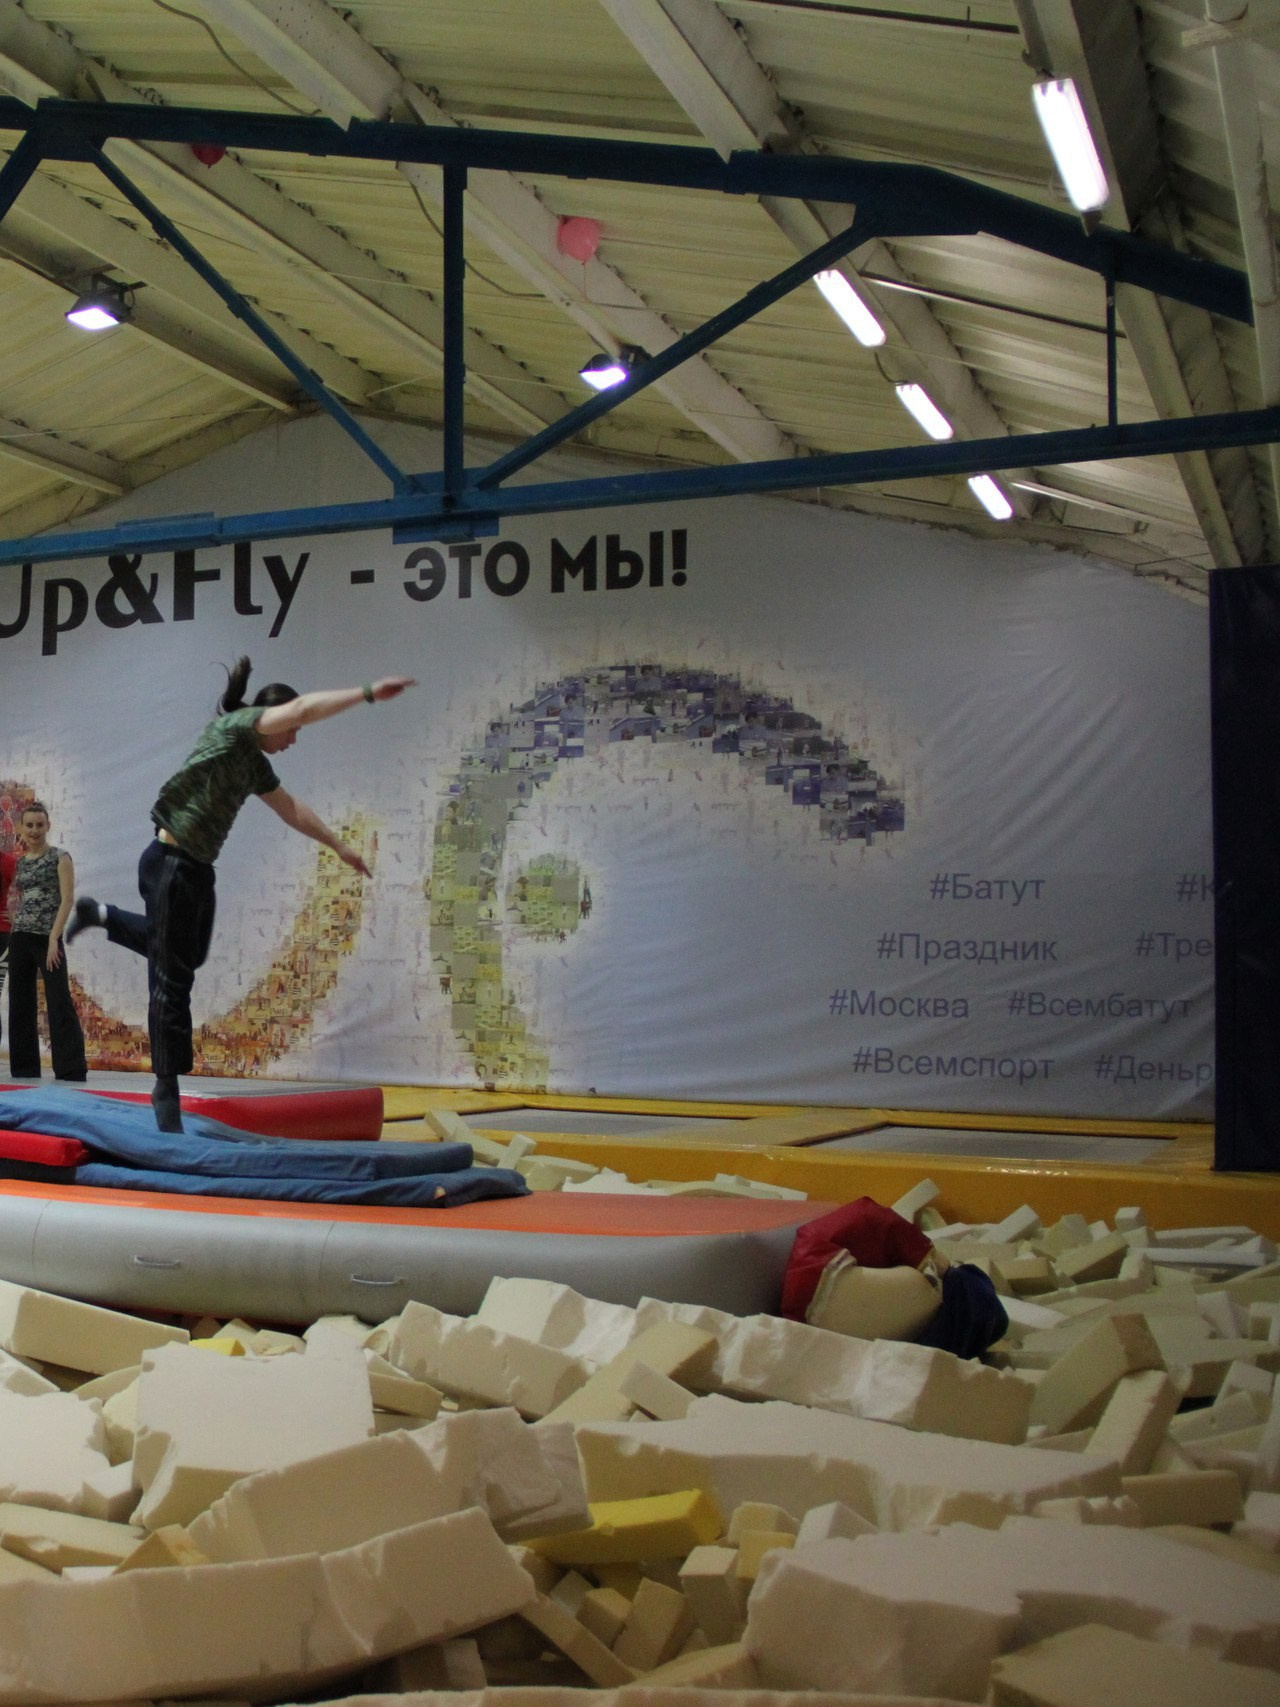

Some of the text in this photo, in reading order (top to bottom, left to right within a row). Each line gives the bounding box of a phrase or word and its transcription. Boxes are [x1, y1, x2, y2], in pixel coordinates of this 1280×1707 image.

[929, 872, 1046, 906] #Батут
[876, 931, 1059, 966] #Праздник
[1135, 930, 1213, 963] #Тре
[828, 988, 970, 1018] #Москва
[1007, 990, 1194, 1024] #Всембатут
[852, 1046, 1055, 1084] #Всемспорт
